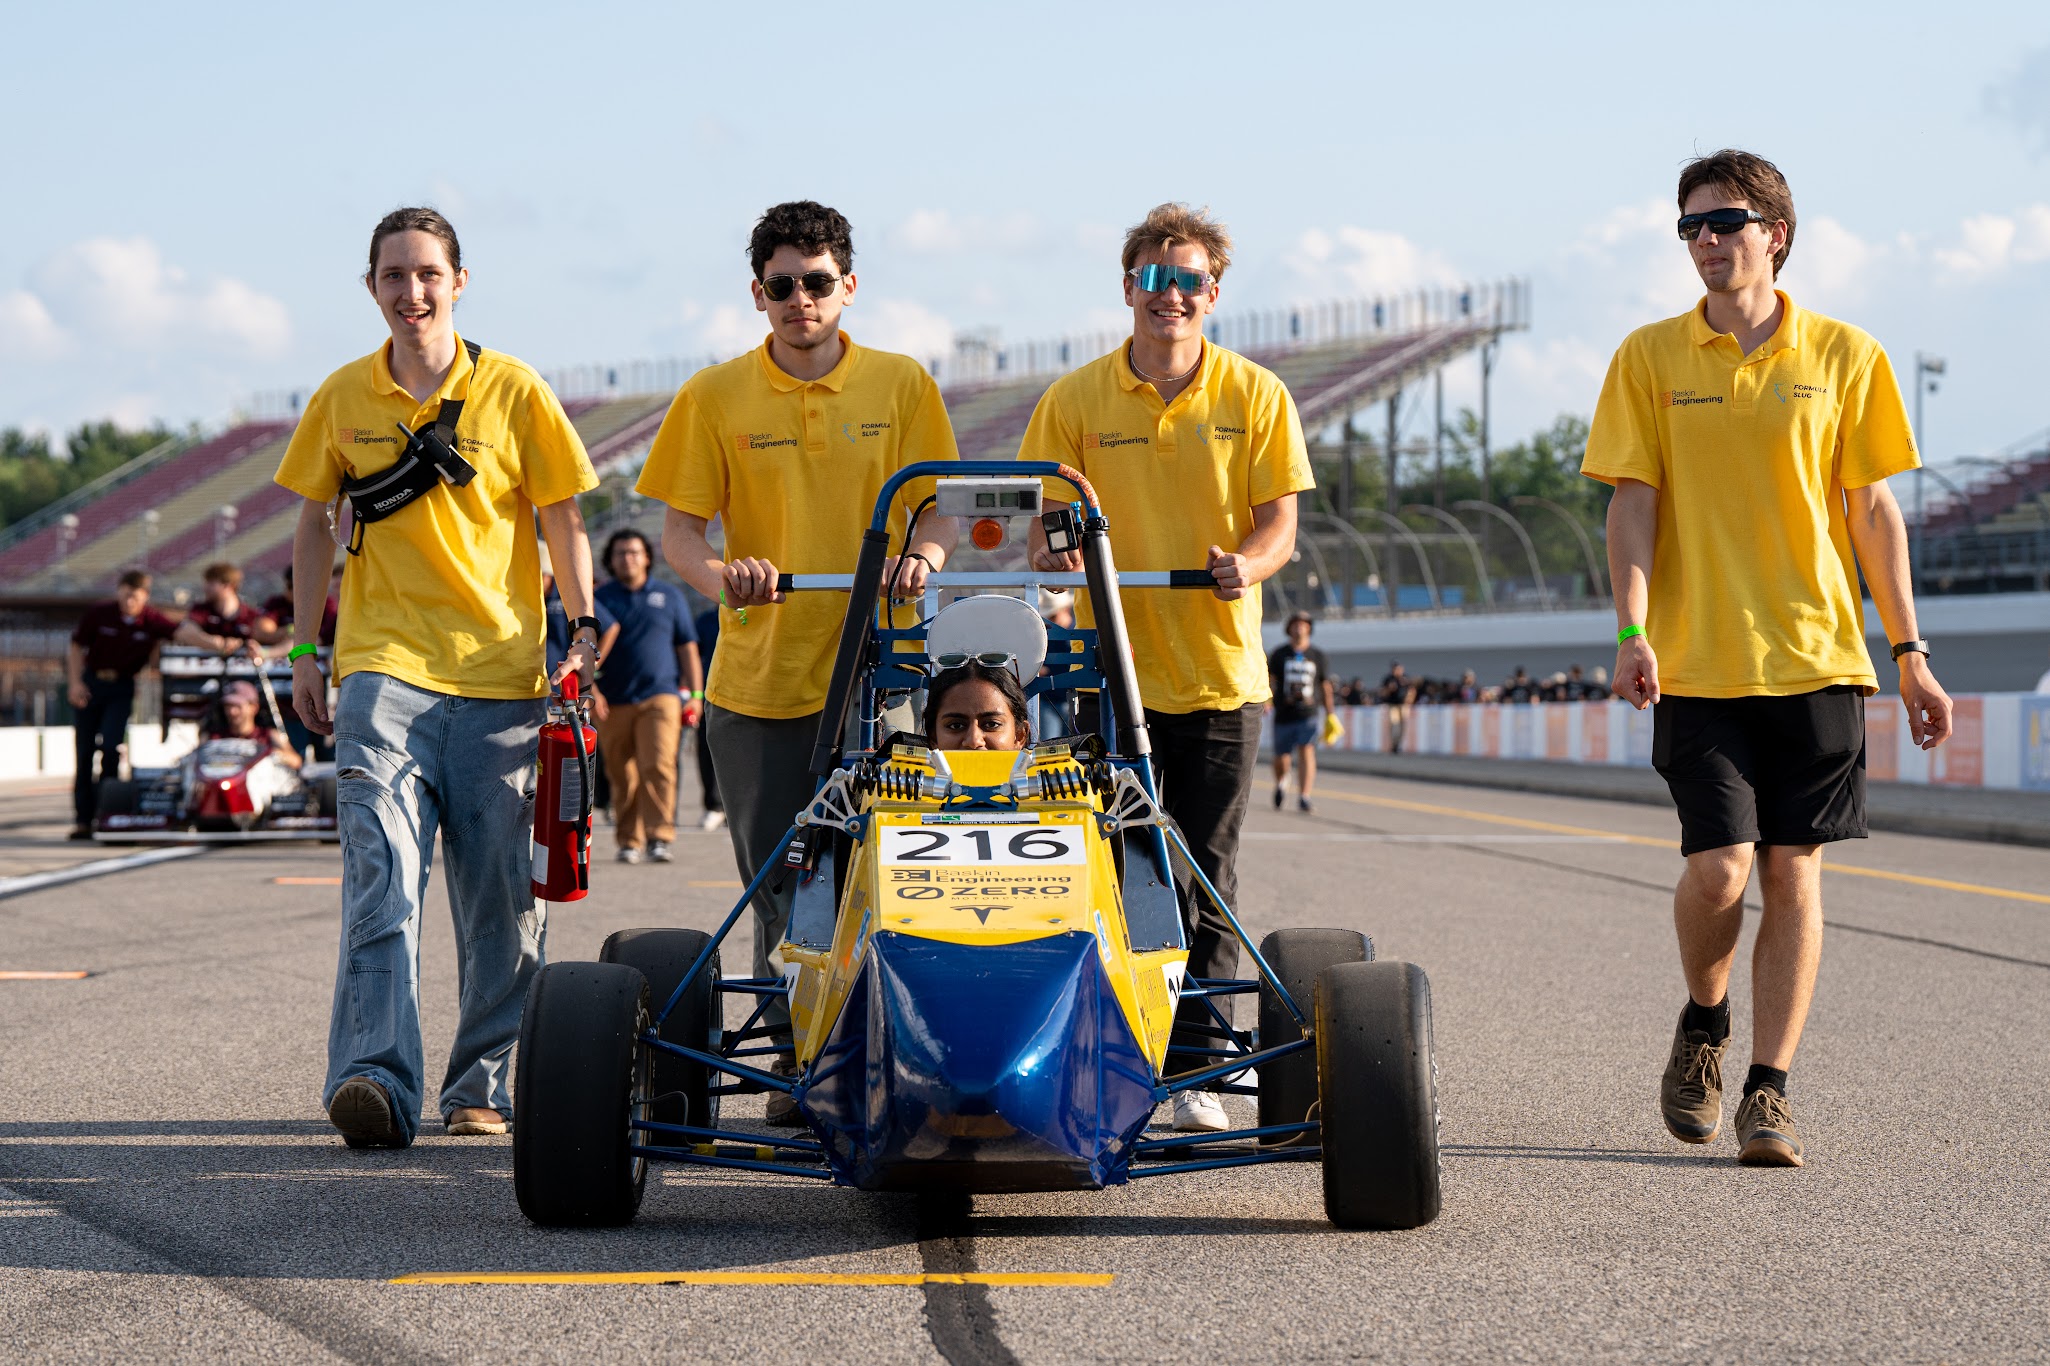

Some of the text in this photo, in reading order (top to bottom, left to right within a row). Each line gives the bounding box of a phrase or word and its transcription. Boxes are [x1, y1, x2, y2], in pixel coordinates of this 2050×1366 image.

[1671, 389, 1696, 398] Baskin
[1793, 384, 1827, 394] FORMULA
[1672, 395, 1723, 406] Engineering
[861, 422, 891, 430] FORMULA
[1214, 426, 1246, 435] FORMULA
[354, 435, 398, 445] Engineering
[748, 432, 773, 441] Baskin
[1098, 430, 1122, 440] Baskin
[1214, 433, 1232, 441] SLUG
[461, 437, 495, 449] FORMULA
[750, 437, 797, 450] Engineering
[1099, 436, 1149, 448] Engineering
[461, 445, 480, 453] SLUG
[373, 488, 413, 510] HONDA
[896, 829, 1069, 860] 216
[936, 875, 1071, 884] Engineering
[951, 885, 1069, 896] ZERO
